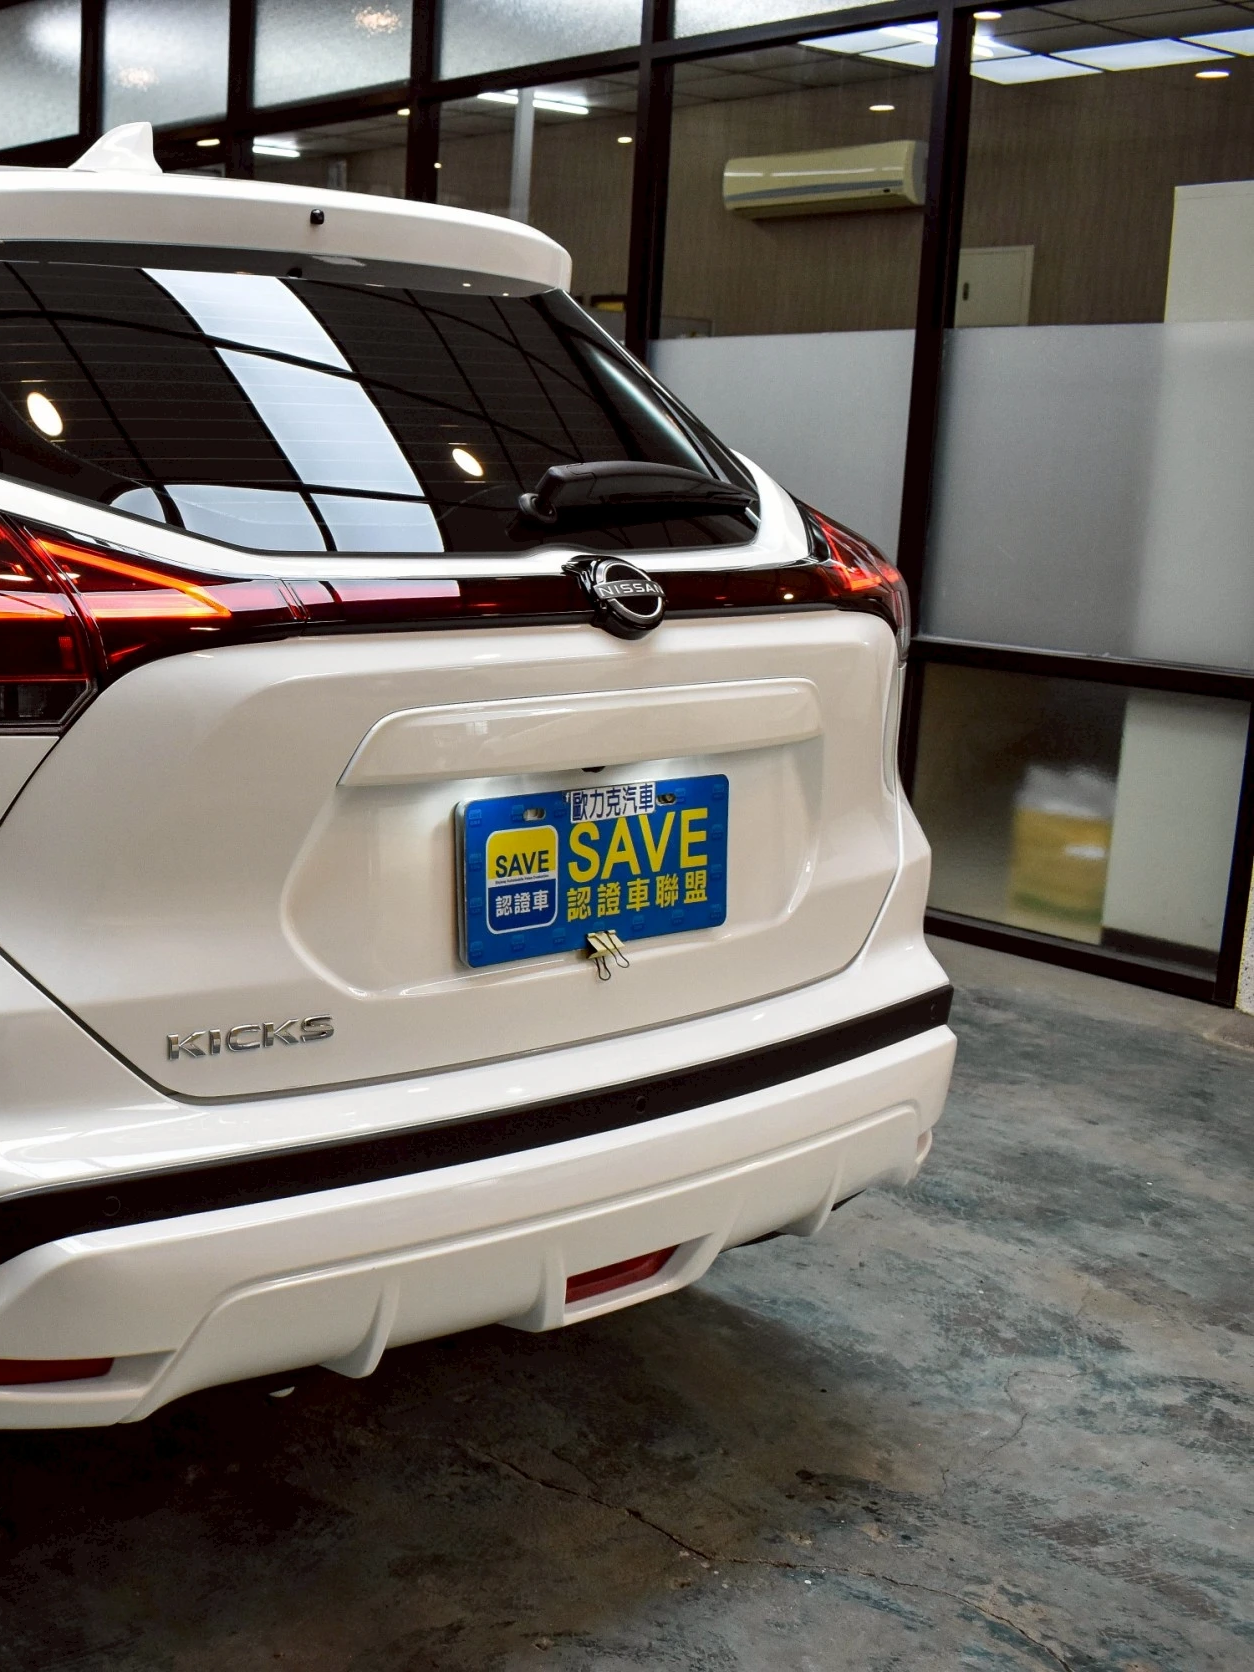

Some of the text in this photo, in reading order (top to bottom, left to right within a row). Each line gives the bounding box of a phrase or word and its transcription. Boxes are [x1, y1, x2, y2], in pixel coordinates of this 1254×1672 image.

[598, 582, 665, 597] NISSAN
[572, 783, 654, 821] 歐力克汽車
[495, 850, 550, 878] SAVE
[568, 808, 708, 883] SAVE
[495, 889, 550, 918] 認證車
[566, 870, 708, 923] 認證車聯盟
[166, 1013, 335, 1061] KICKS
